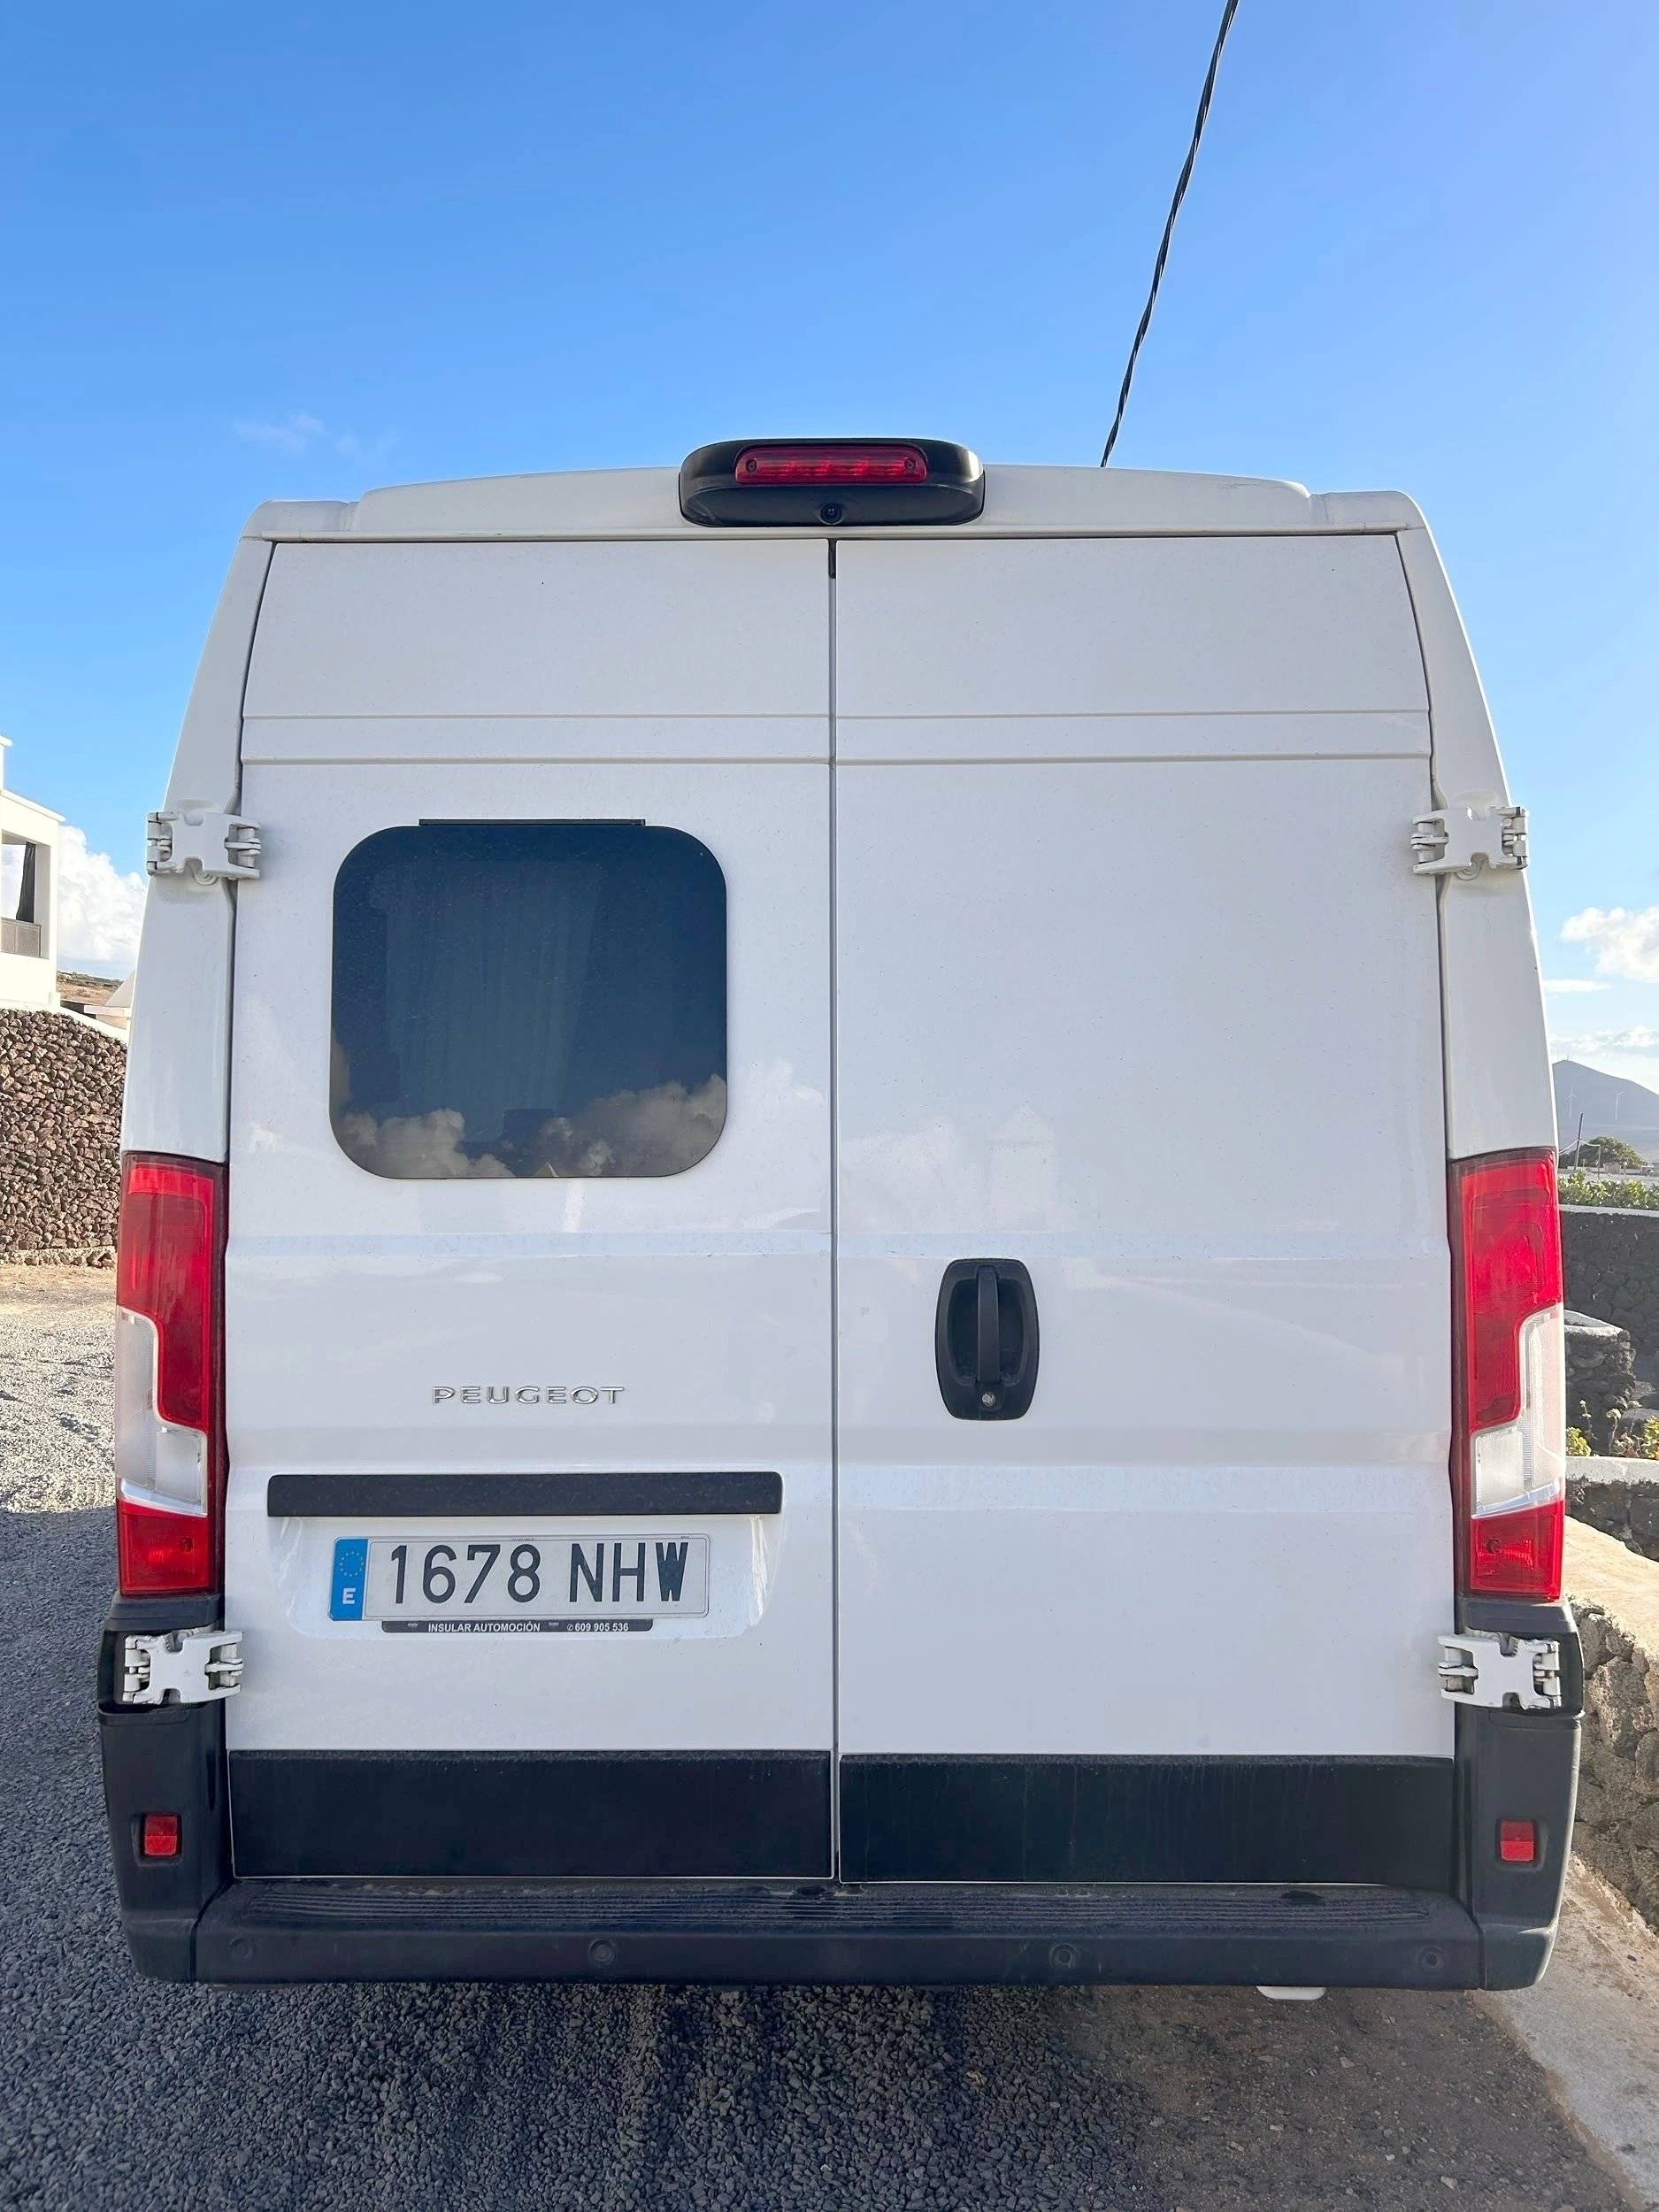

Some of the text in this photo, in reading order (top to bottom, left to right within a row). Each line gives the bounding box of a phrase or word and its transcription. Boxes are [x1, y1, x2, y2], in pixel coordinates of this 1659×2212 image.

[432, 1386, 625, 1405] PEUGEOT
[390, 1541, 689, 1605] 1678 NHW
[342, 1587, 356, 1605] E
[428, 1623, 472, 1632] INSULAR
[473, 1621, 541, 1632] AUTOMOCIÓN
[574, 1623, 591, 1632] 609
[594, 1623, 610, 1632] 905
[612, 1623, 629, 1632] 536
